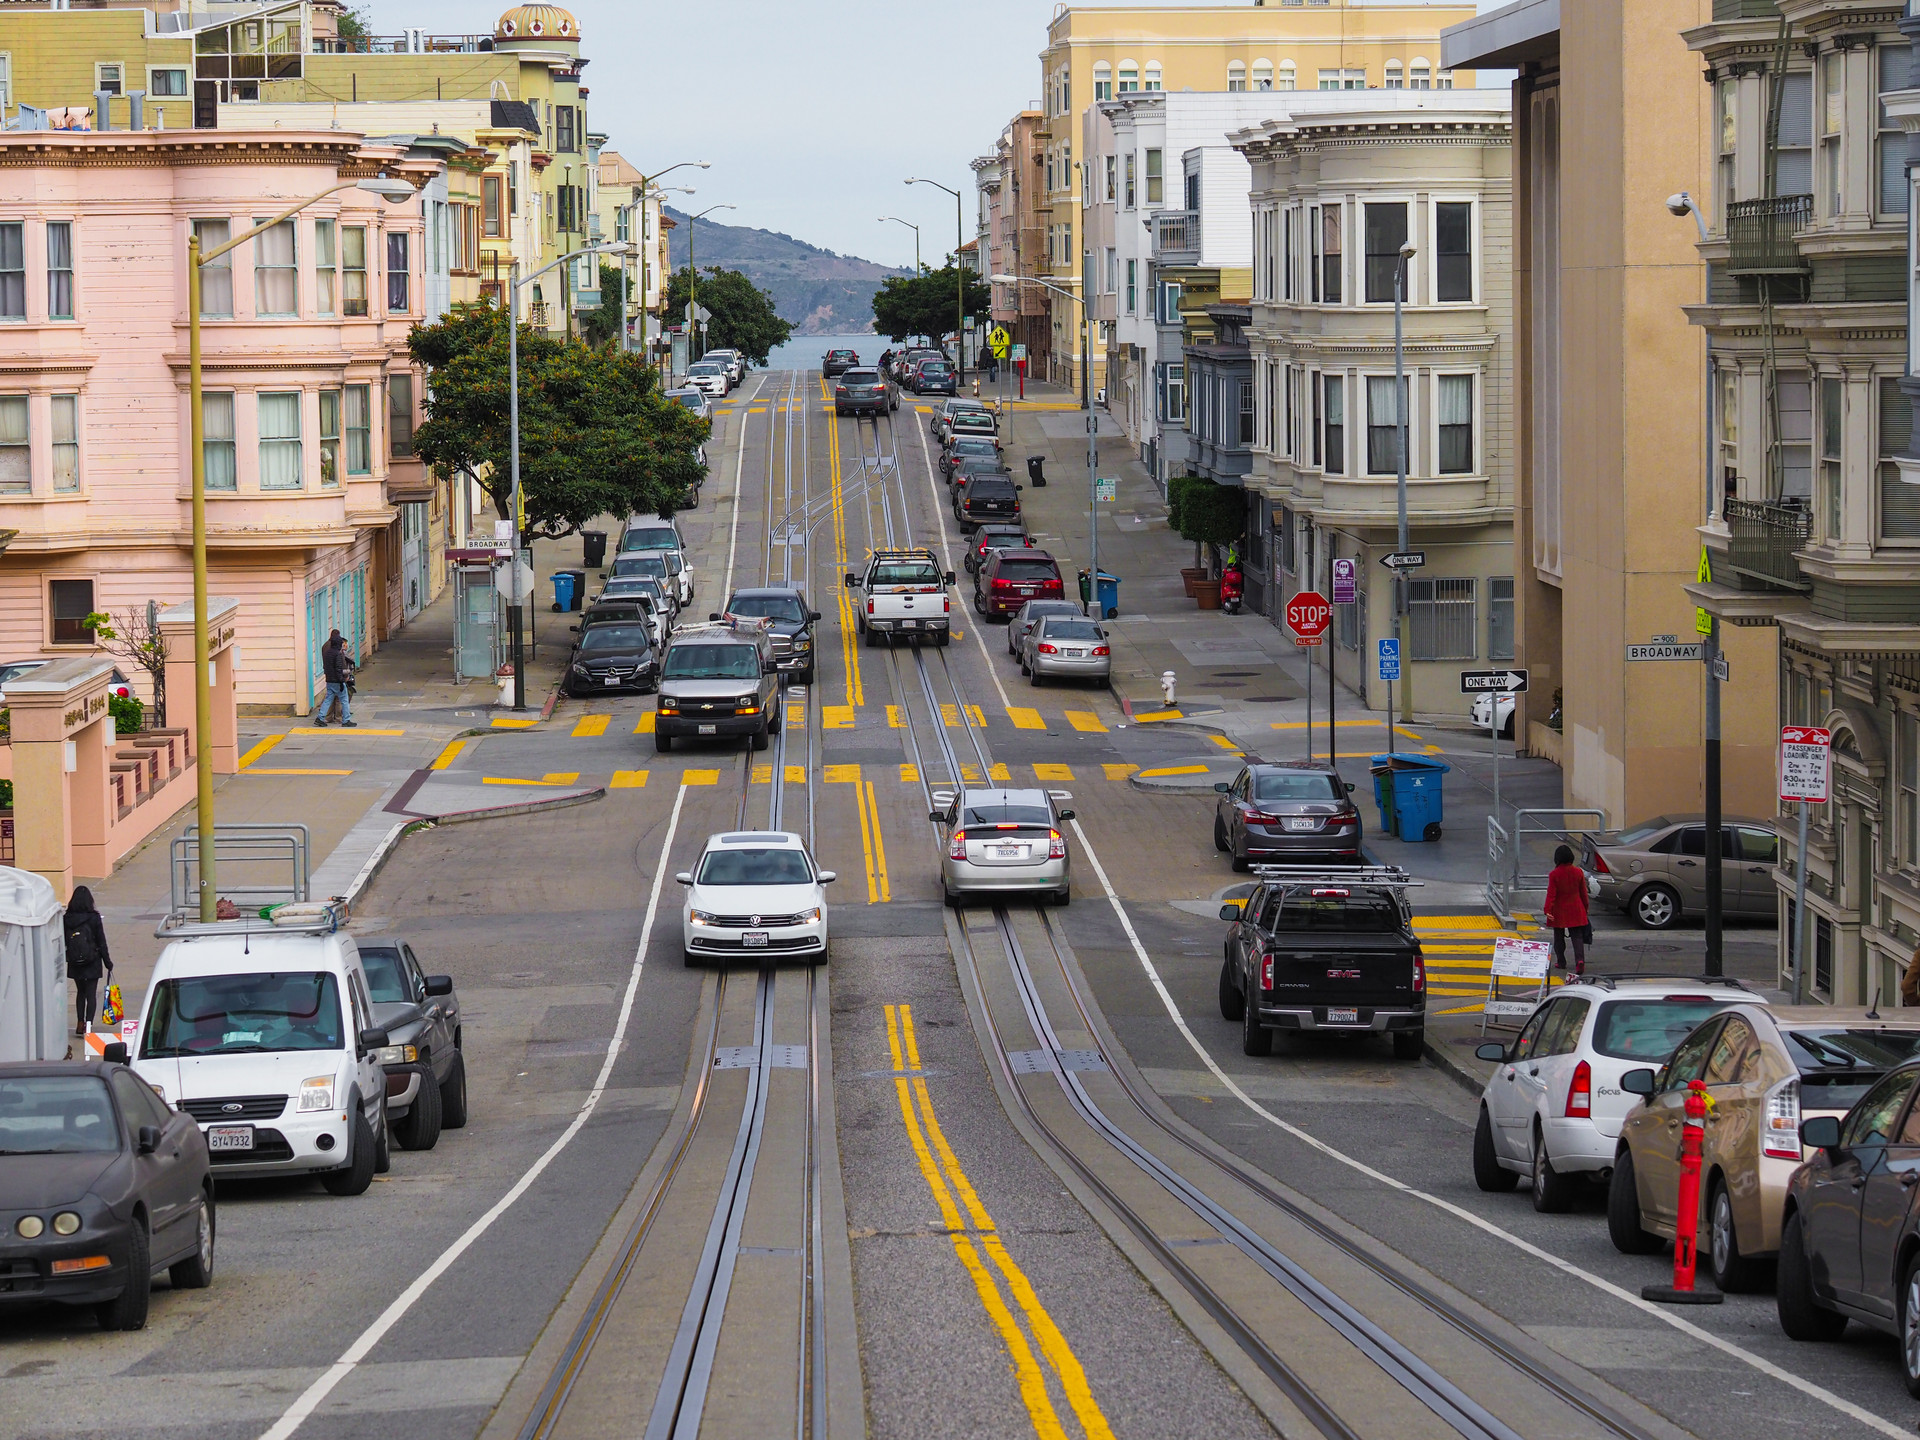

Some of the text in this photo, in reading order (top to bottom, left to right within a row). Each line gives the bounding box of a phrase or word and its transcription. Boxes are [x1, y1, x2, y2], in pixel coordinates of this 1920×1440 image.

[1392, 556, 1406, 564] ONE
[1290, 606, 1328, 623] STOP
[1661, 635, 1675, 643] 900
[1631, 646, 1698, 658] BROADWAY
[1467, 676, 1508, 687] ONE WAY
[1787, 744, 1823, 753] PASSENGER
[1783, 751, 1809, 760] LOADING
[1327, 969, 1361, 979] GMC
[1597, 1086, 1621, 1098] focus
[211, 1134, 251, 1148] 8Y47332
